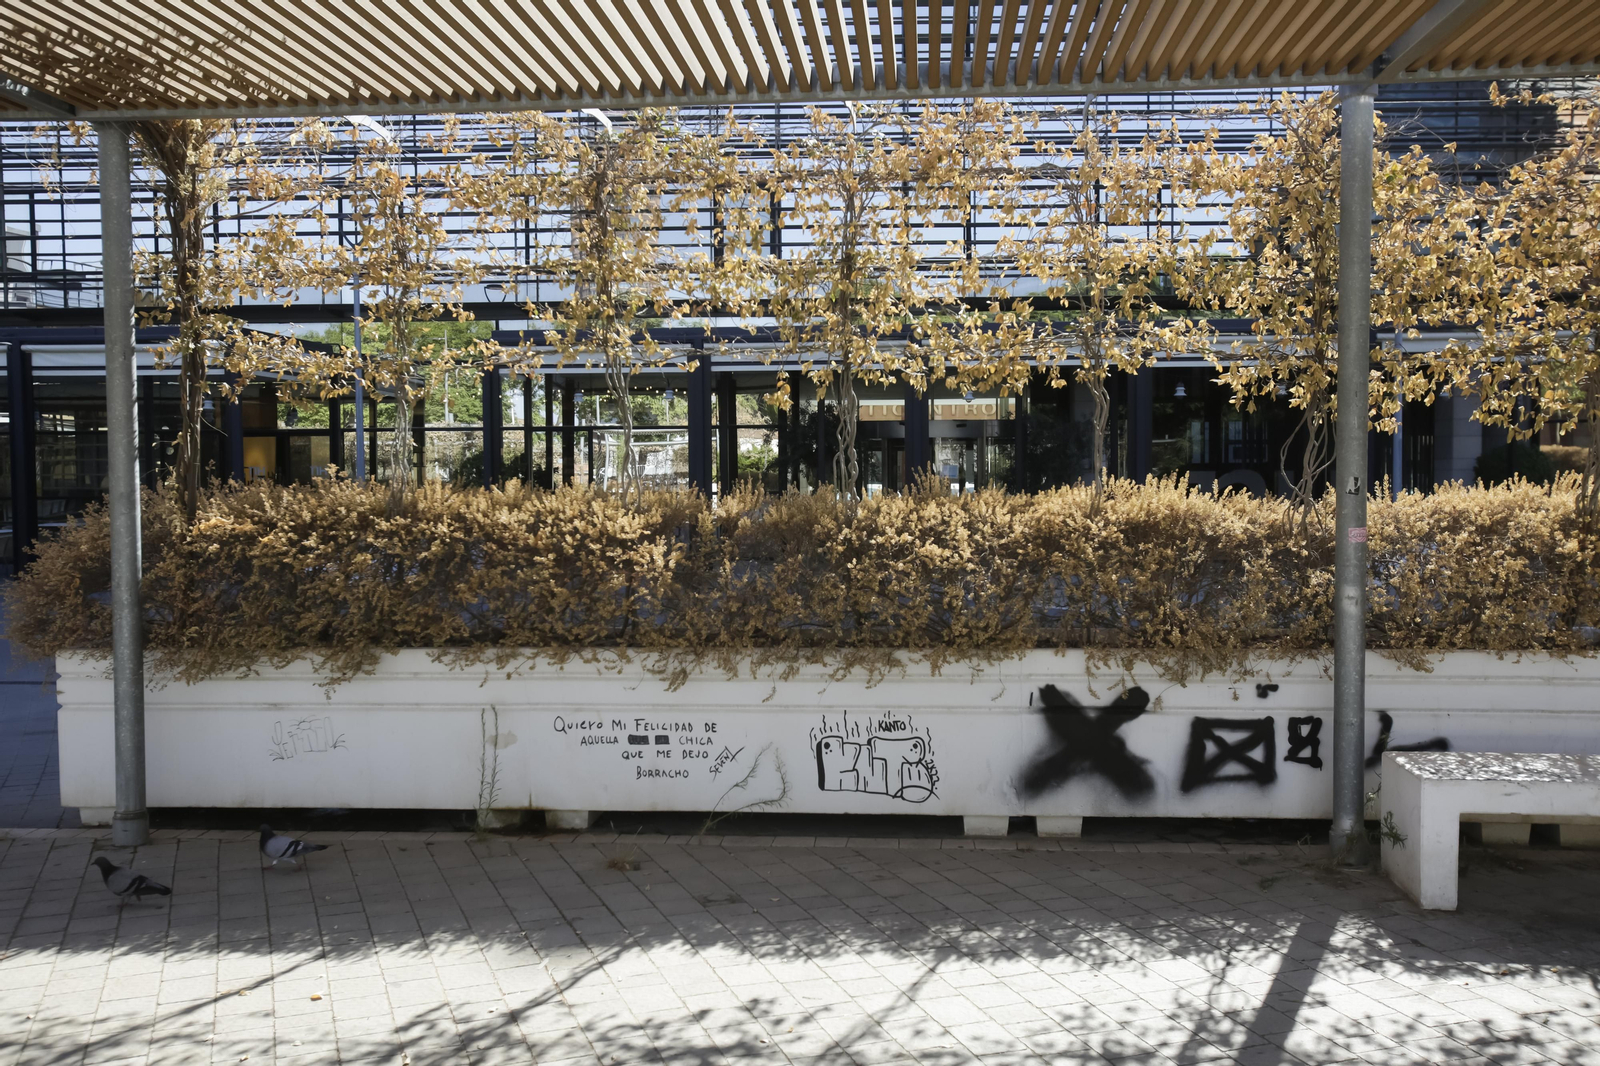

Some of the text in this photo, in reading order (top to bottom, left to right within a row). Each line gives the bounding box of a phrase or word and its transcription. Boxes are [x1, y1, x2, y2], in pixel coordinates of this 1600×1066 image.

[705, 722, 717, 733] DE
[878, 719, 906, 733] KANTO
[581, 735, 619, 746] AQUELLA
[679, 736, 713, 745] CHICA
[622, 749, 708, 760] QUE ME DEJO
[636, 766, 689, 780] BORRACHO
